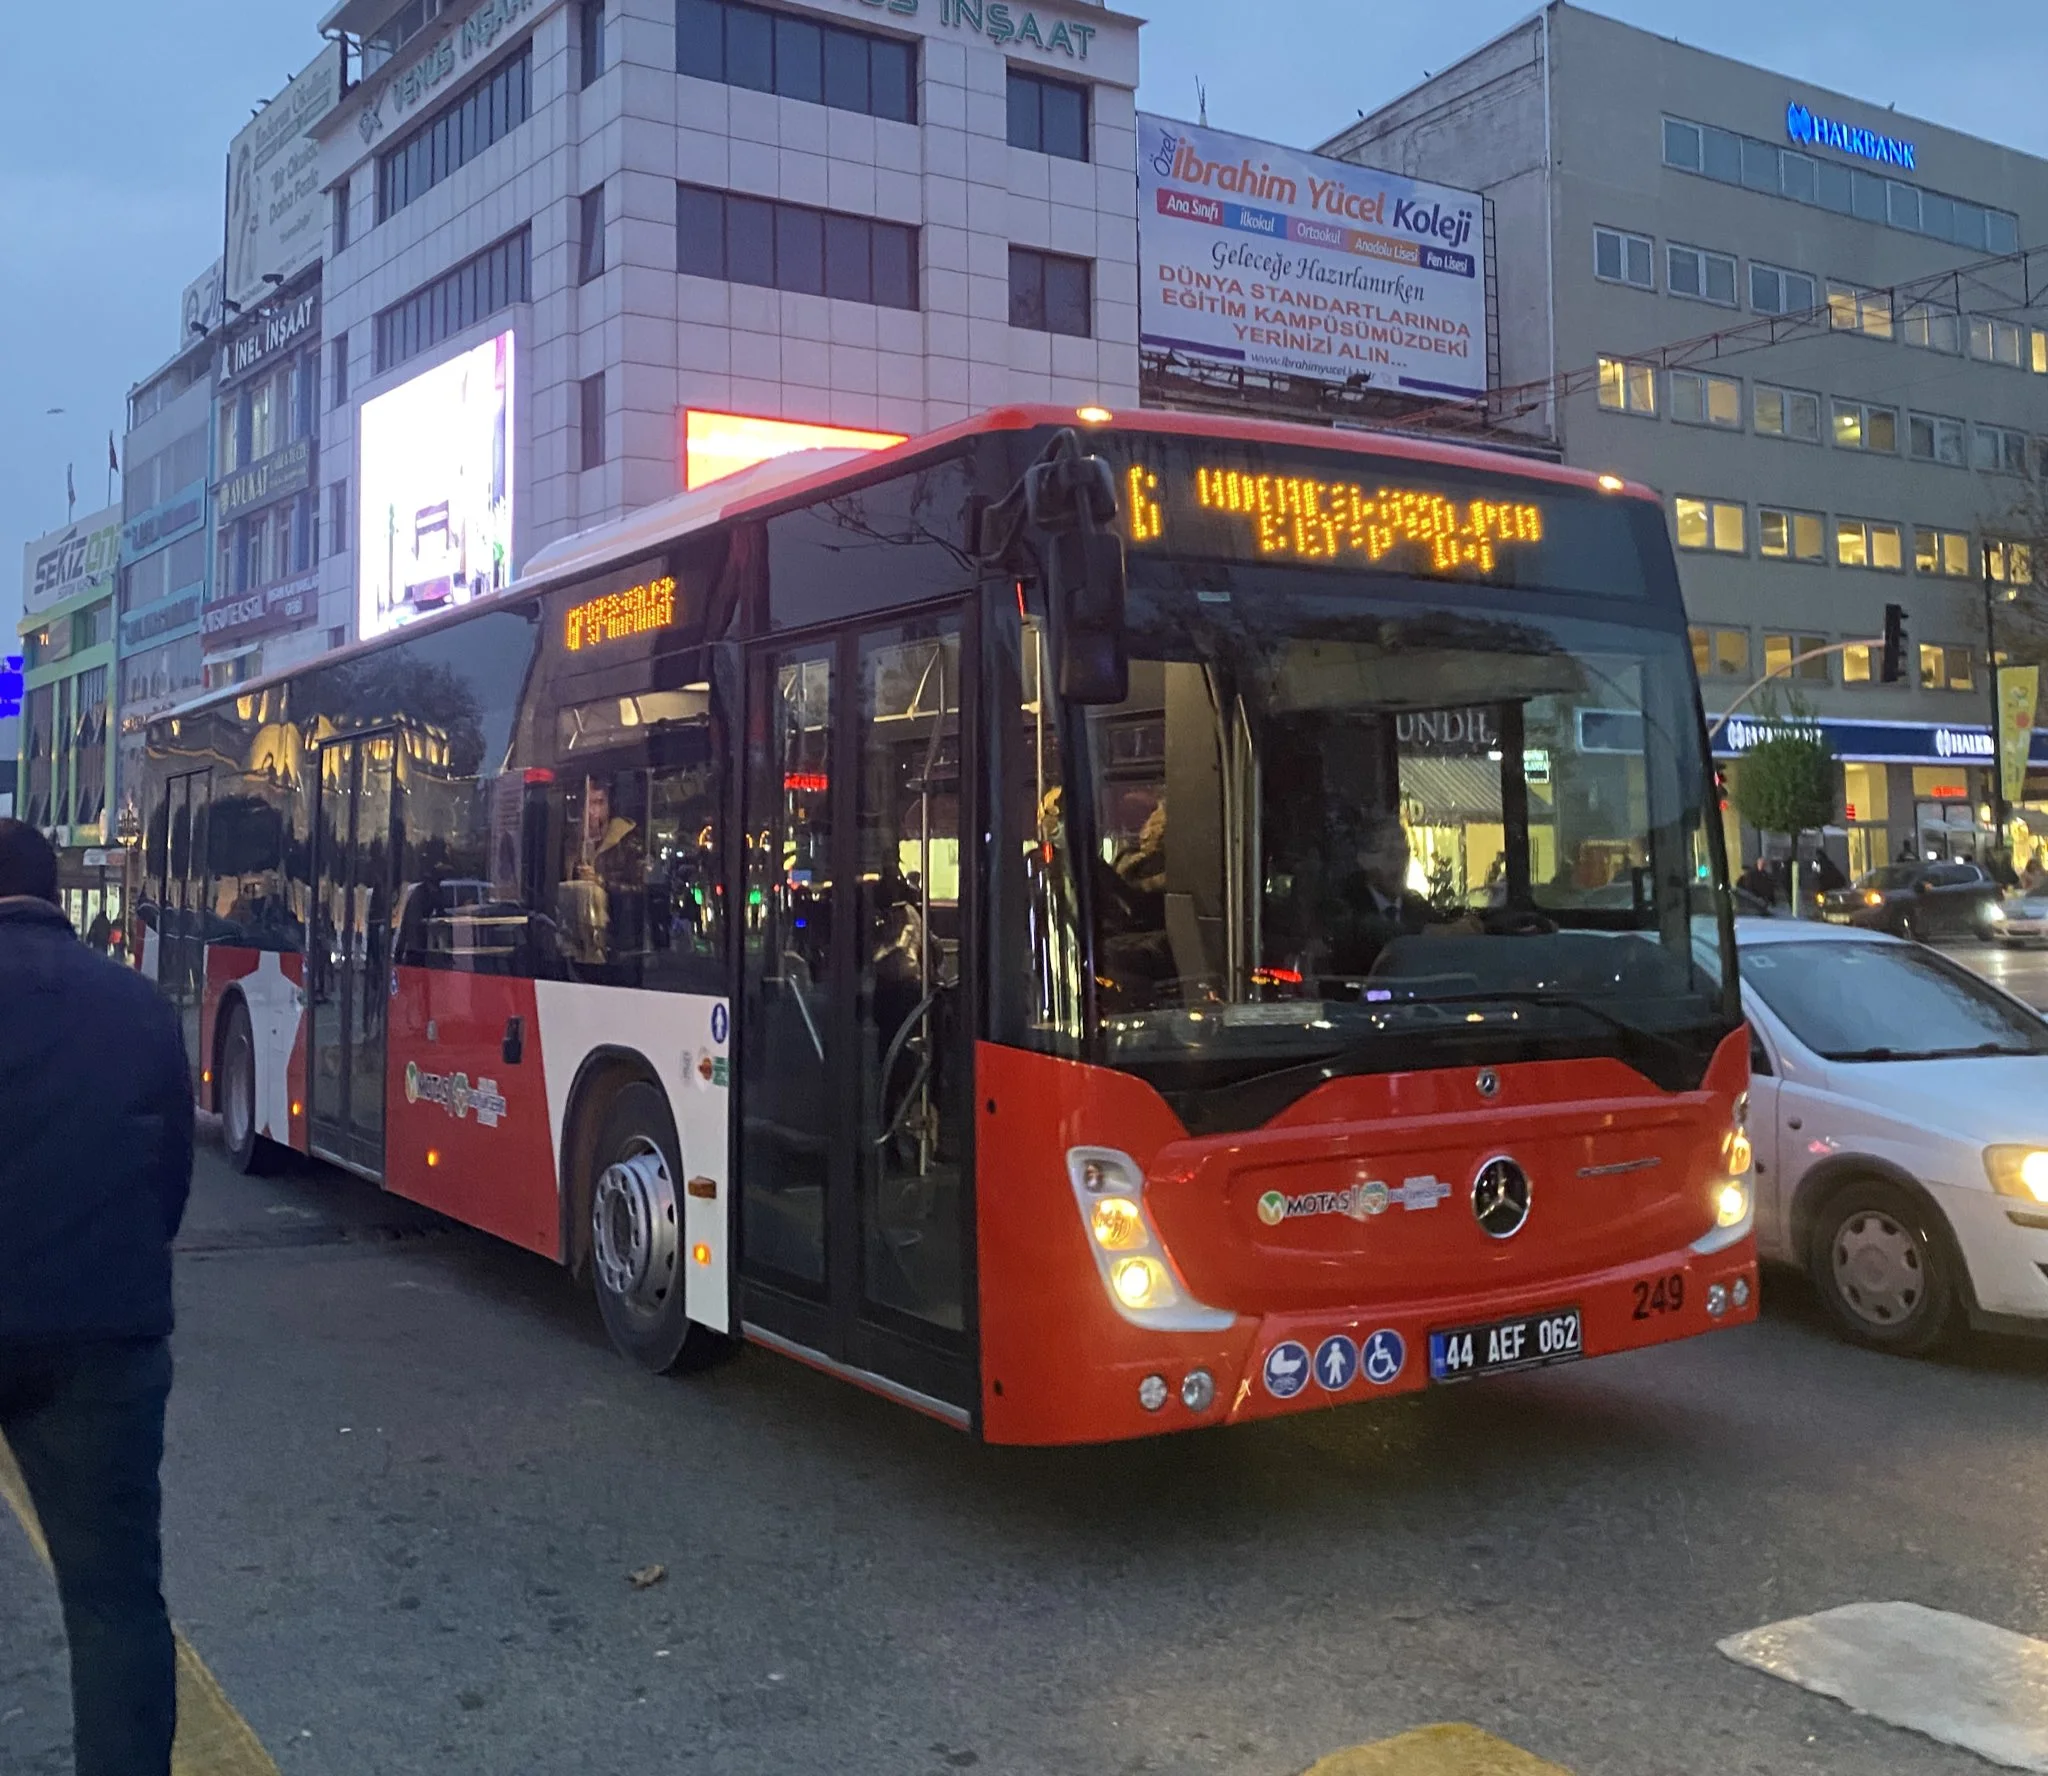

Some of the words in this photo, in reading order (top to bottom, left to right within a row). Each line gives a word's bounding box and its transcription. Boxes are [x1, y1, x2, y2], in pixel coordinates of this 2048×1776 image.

[461, 0, 534, 60] İNŞA
[1150, 128, 1178, 177] Özel
[1814, 115, 1916, 171] HALKBANK
[1167, 194, 1190, 212] Ana
[1307, 176, 1386, 226] Yücel
[1392, 197, 1473, 248] Koleji
[1297, 222, 1342, 245] Ortaokul
[1355, 237, 1392, 257] Anadolu
[1394, 245, 1419, 262] Lisesi
[1212, 241, 1292, 281] Geleceğe
[1296, 257, 1425, 304] Hazırlanırken
[1427, 251, 1443, 268] Fen
[1444, 254, 1468, 273] Lisesi
[265, 295, 314, 353] İNŞAAT
[1158, 264, 1245, 297] DÜNYA
[1251, 283, 1471, 339] STANDARTLARINDA
[1162, 287, 1246, 319] EĞİTİM
[1254, 305, 1469, 359] KAMPÜSÜMÜZDEKİ
[1232, 322, 1332, 356] YERİNİZİ
[1632, 1273, 1684, 1322] 249
[1446, 1333, 1474, 1371] 44
[1488, 1323, 1527, 1363] AEF
[1538, 1314, 1578, 1354] 062
